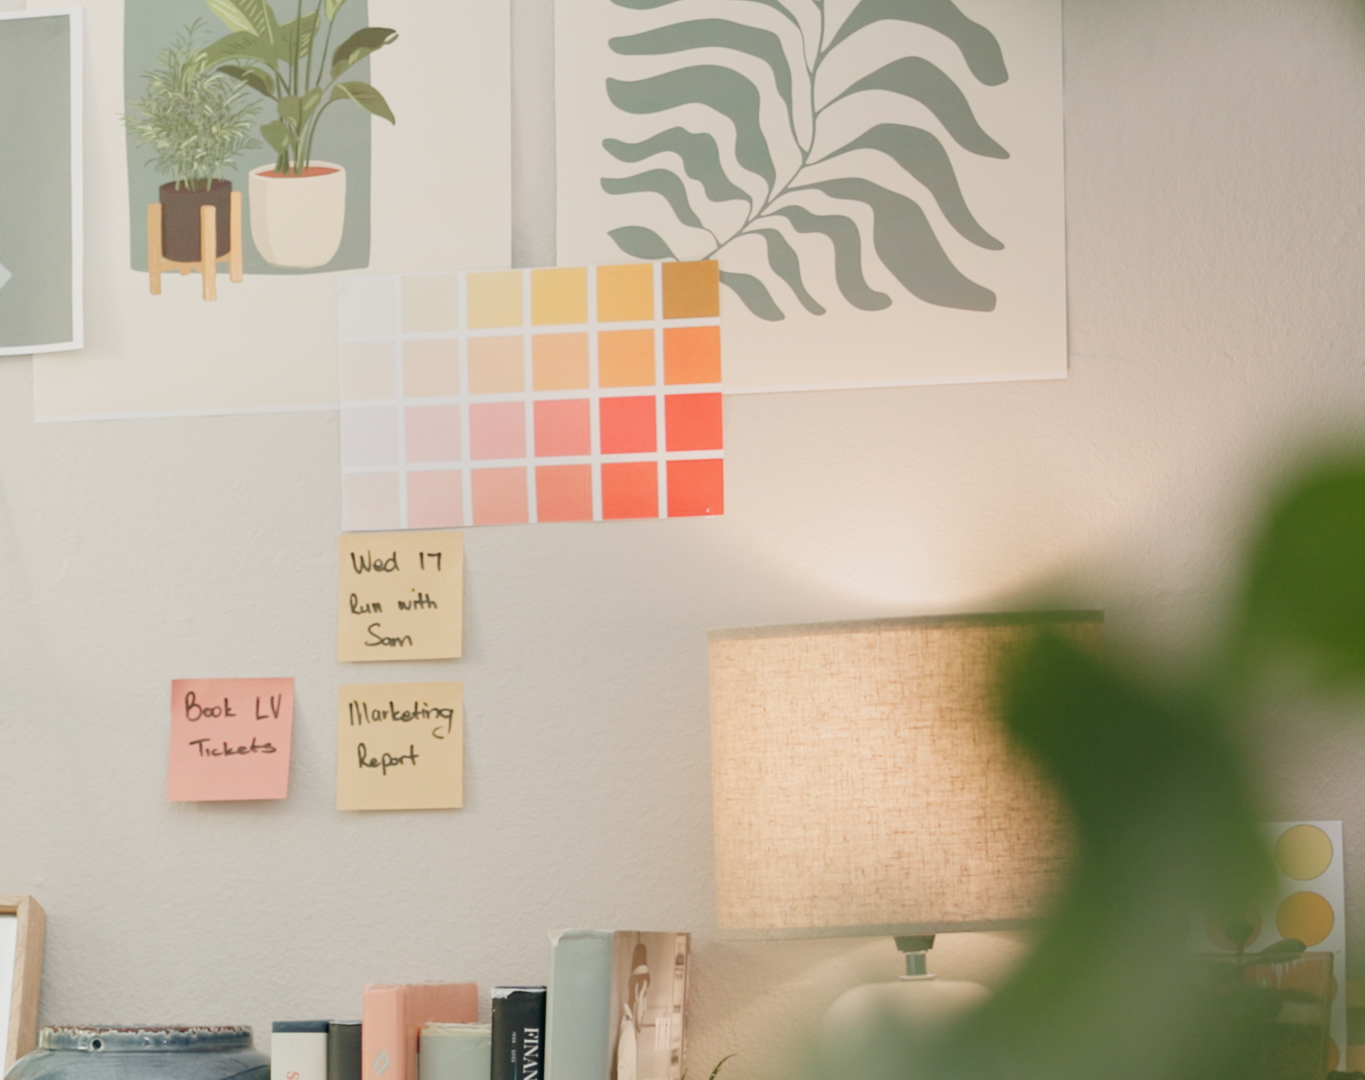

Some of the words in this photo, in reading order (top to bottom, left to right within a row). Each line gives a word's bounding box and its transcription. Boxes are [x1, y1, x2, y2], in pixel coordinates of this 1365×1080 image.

[351, 551, 400, 574] Wed
[419, 552, 442, 572] 17
[398, 589, 438, 613] with
[364, 623, 414, 648] Sam
[185, 691, 237, 722] Book
[256, 694, 283, 720] LV
[349, 700, 454, 739] Marketing
[189, 738, 277, 759] Tickets
[357, 743, 419, 776] Report
